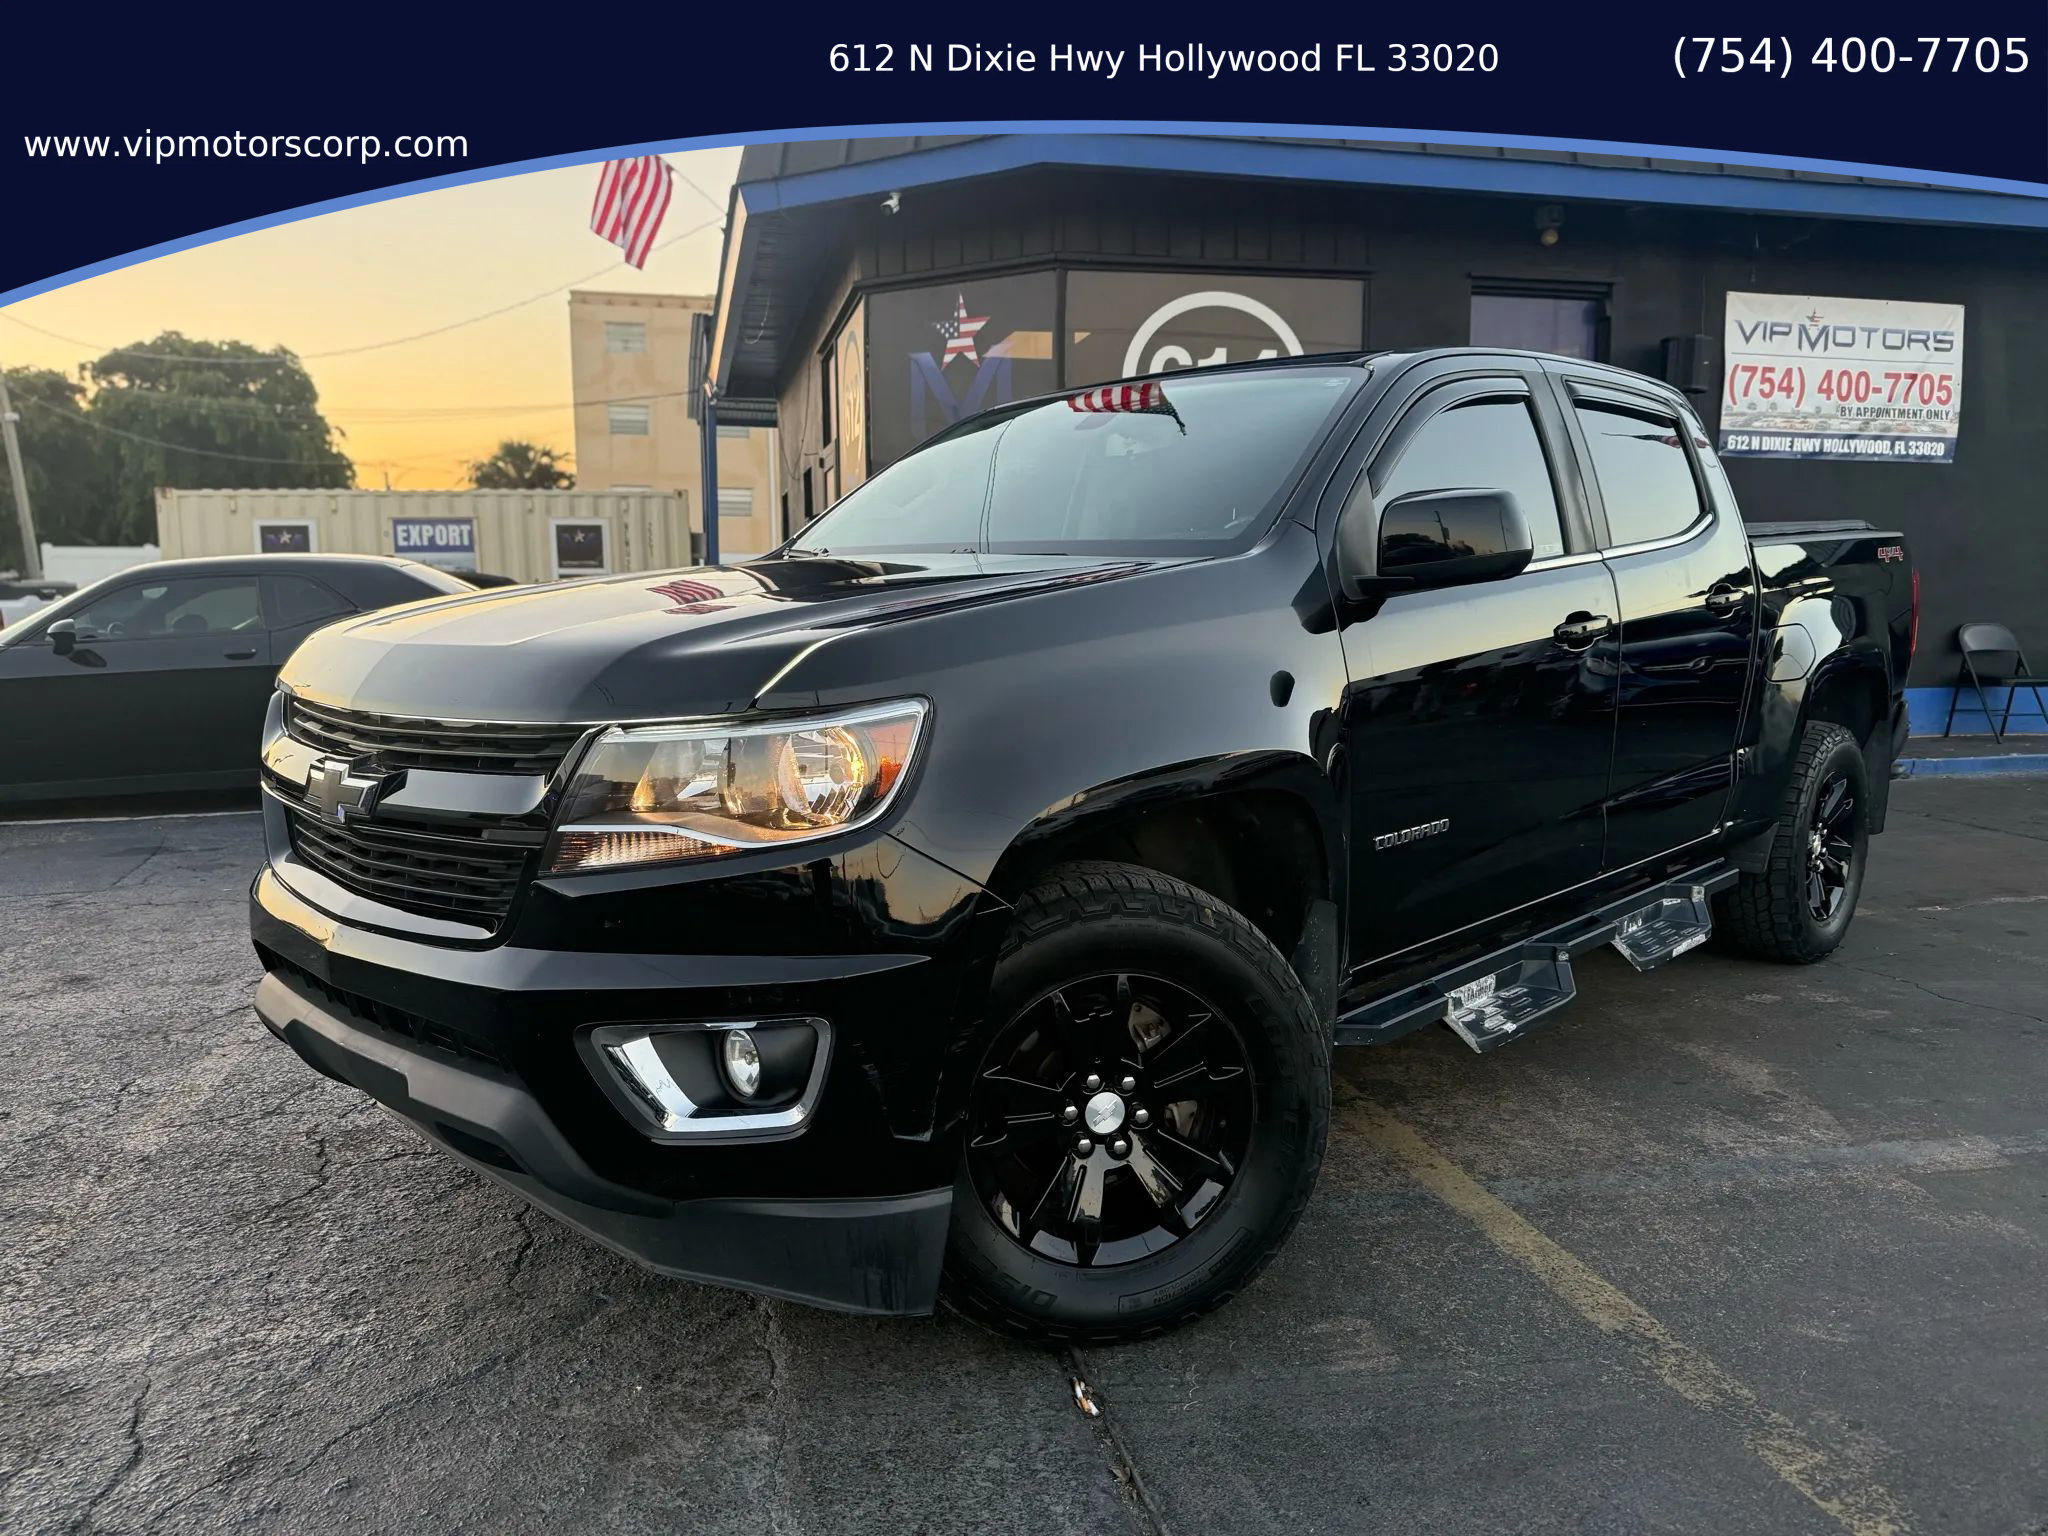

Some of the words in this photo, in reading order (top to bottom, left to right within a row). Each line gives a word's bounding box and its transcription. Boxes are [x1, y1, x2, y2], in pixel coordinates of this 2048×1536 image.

[1734, 319, 1792, 346] VIP
[1798, 322, 1955, 353] MOTORS
[1728, 363, 1806, 409] (754)
[1817, 368, 1954, 407] 400-7705
[1840, 406, 1854, 418] BY
[1855, 407, 1924, 420] APPOINTMENT
[1926, 409, 1951, 421] ONLY
[1727, 434, 1750, 450] 612
[1751, 435, 1760, 451] N
[1761, 435, 1793, 452] DIXIE
[1793, 437, 1822, 453] HWY
[1823, 438, 1893, 456] HOLLYWOOD,
[1894, 441, 1907, 455] FL
[1908, 441, 1945, 456] 33020
[396, 524, 471, 546] EXPORT
[1375, 818, 1450, 851] COLORADO
